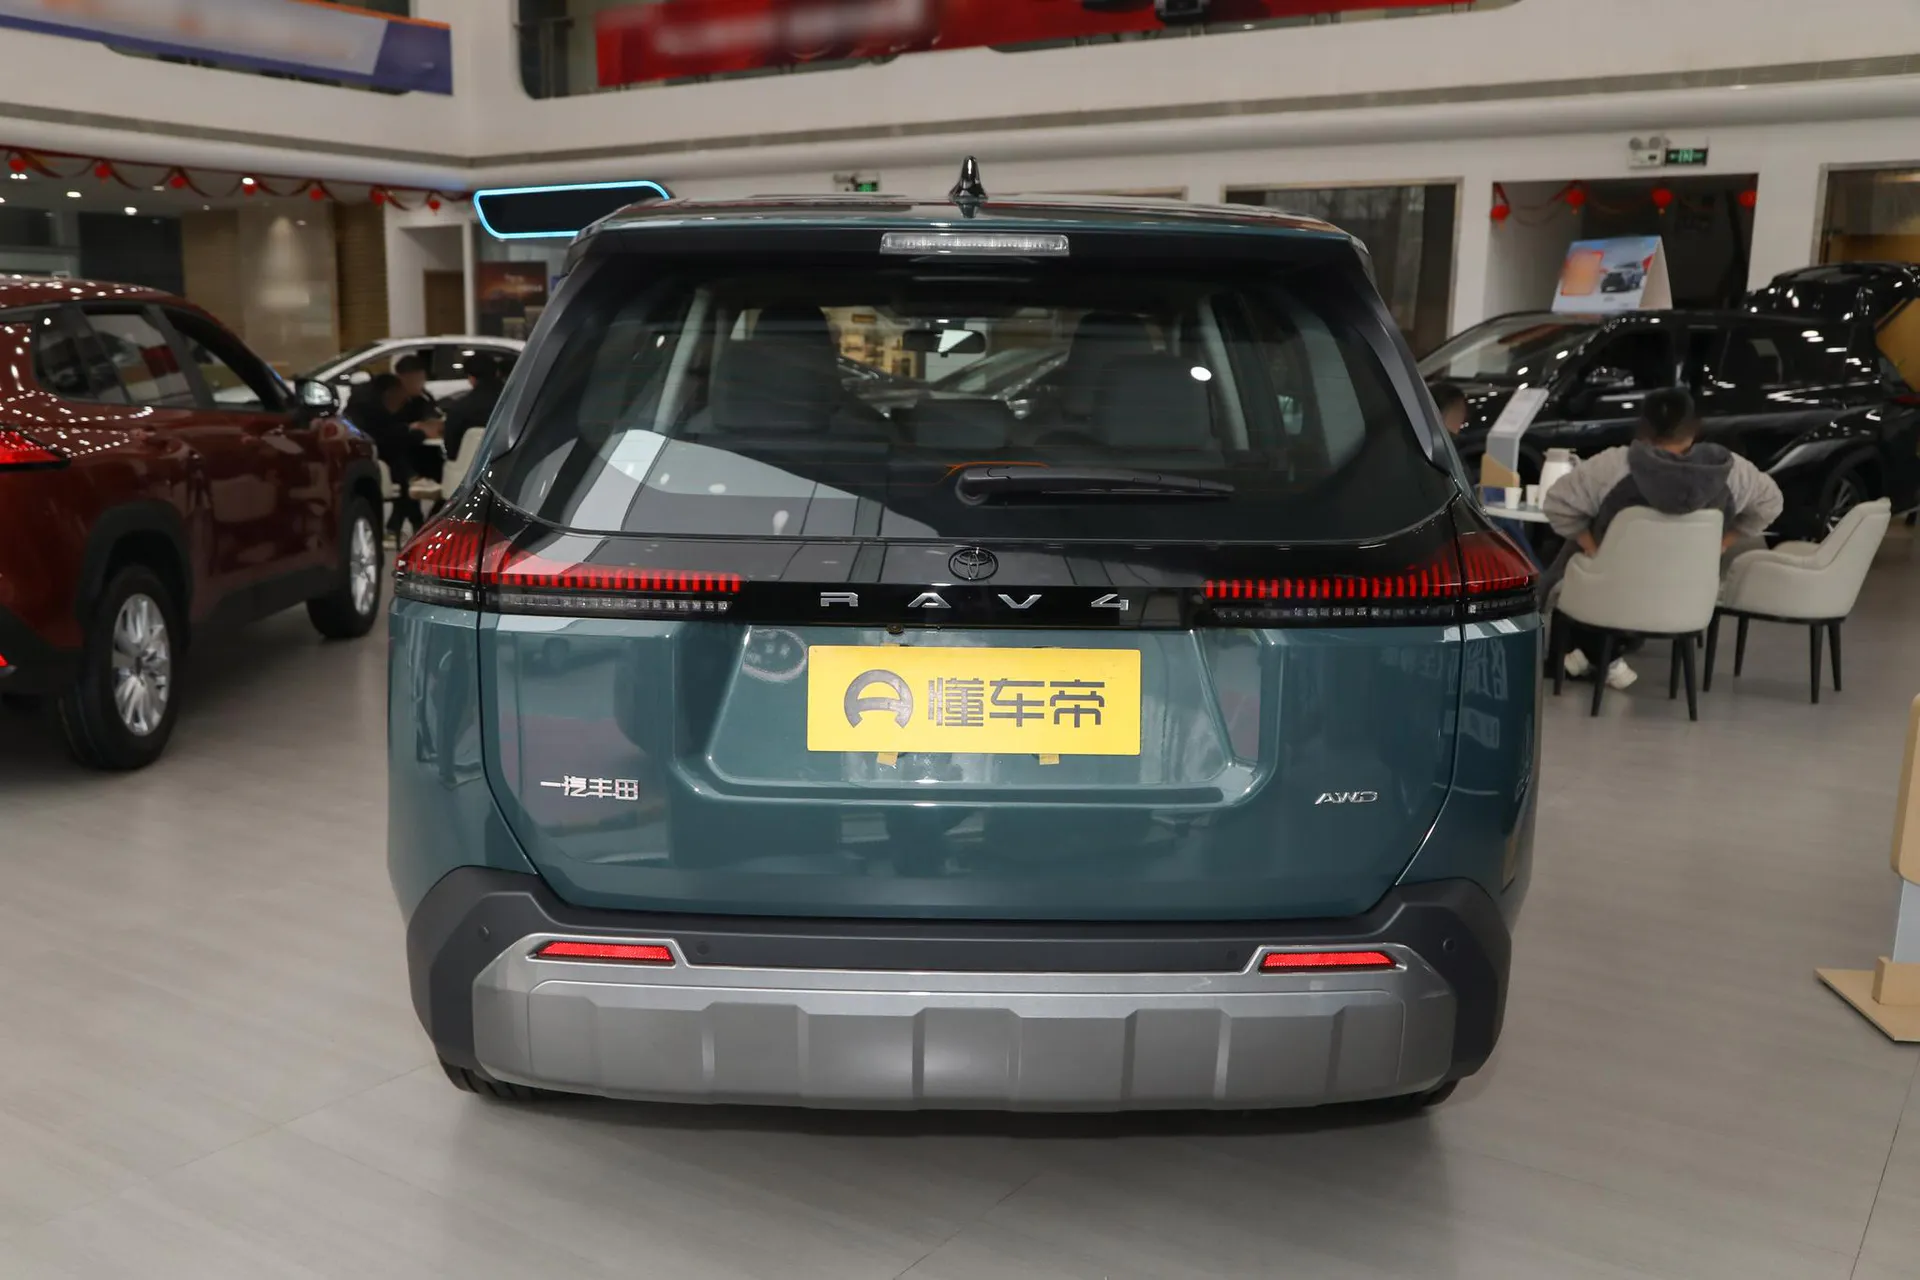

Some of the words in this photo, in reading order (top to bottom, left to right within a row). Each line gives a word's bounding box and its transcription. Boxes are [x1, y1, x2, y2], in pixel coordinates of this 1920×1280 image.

[820, 591, 1129, 611] RAV4
[928, 676, 1105, 728] 懂车帝
[540, 776, 639, 801] 一汽丰田
[1314, 790, 1378, 805] AWD
